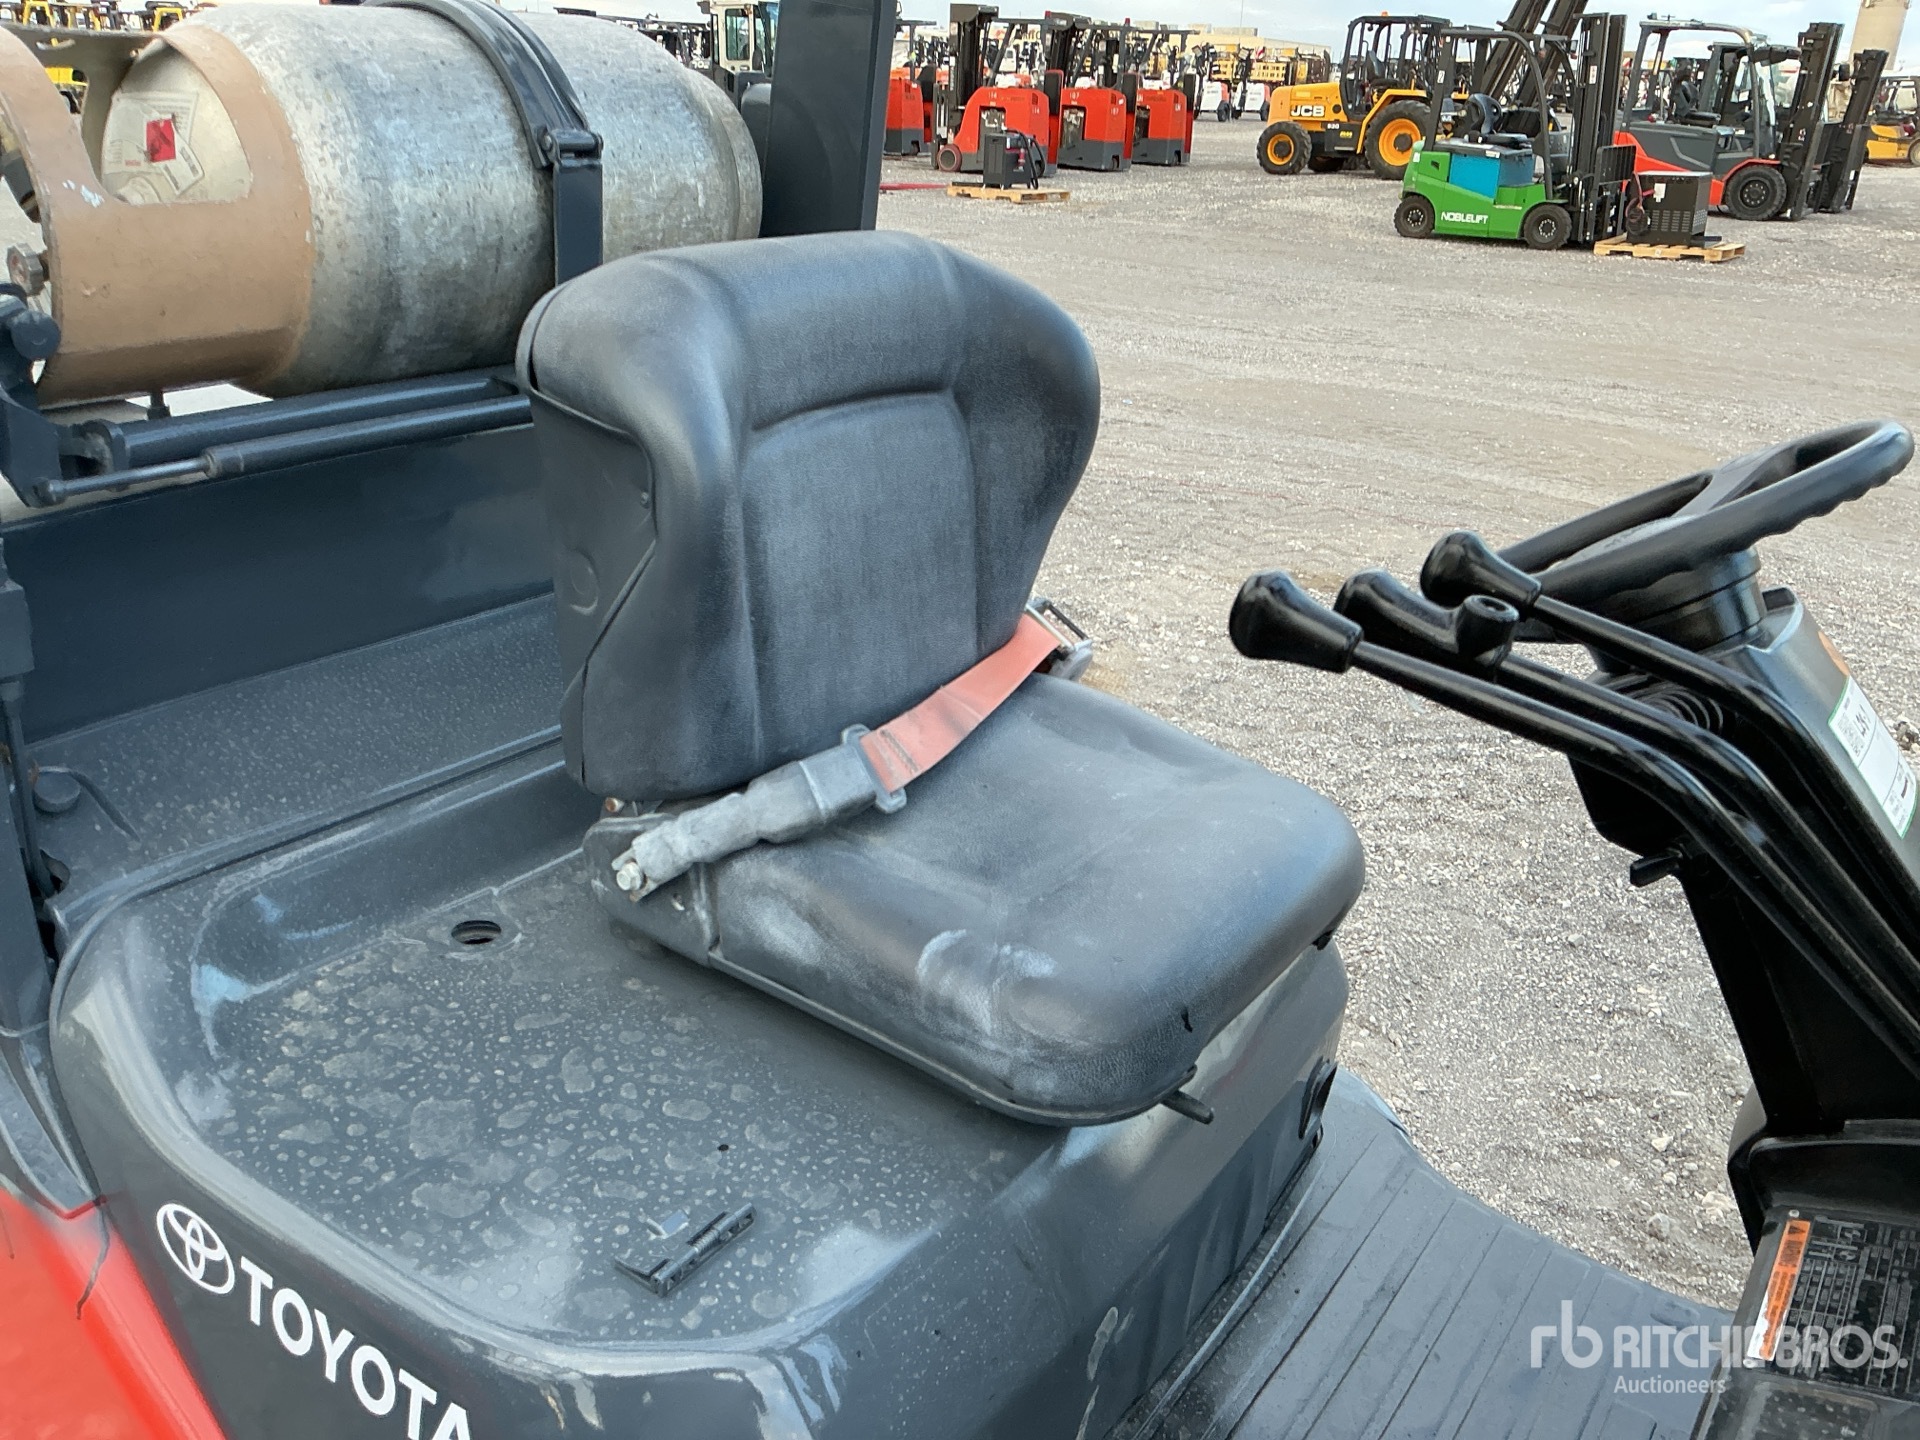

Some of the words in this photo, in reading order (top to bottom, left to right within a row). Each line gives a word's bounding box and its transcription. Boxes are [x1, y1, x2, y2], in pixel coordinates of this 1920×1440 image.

[1290, 105, 1325, 117] JCB
[1440, 211, 1489, 224] NOBLELIFT
[240, 1256, 471, 1440] TOYOTA
